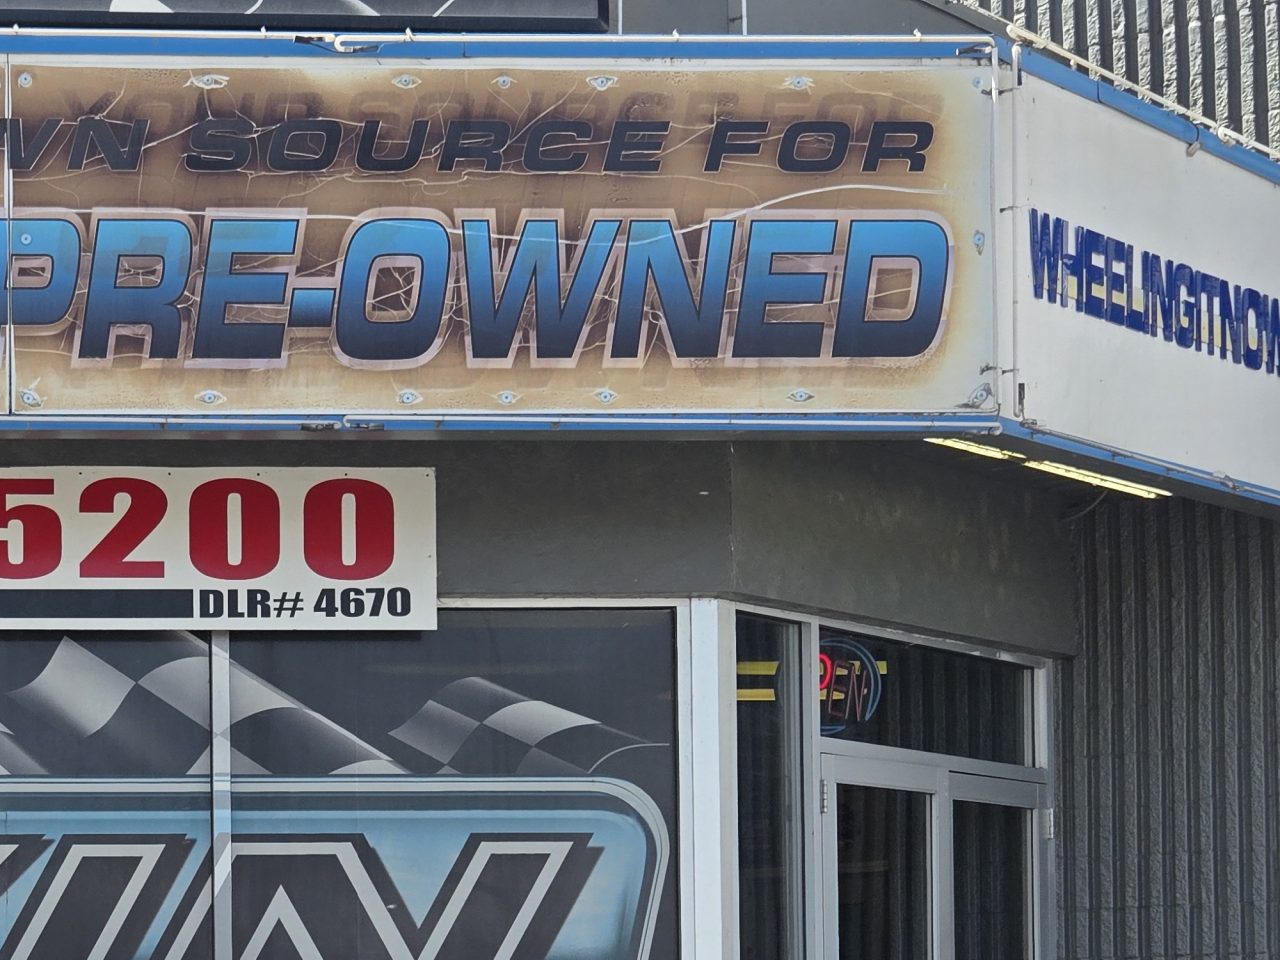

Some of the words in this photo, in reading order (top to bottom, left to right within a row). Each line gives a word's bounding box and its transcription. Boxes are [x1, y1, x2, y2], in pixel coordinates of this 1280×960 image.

[184, 117, 671, 173] SOURCE
[703, 119, 936, 174] FOR
[199, 588, 304, 618] DLR#
[313, 587, 411, 618] 4670
